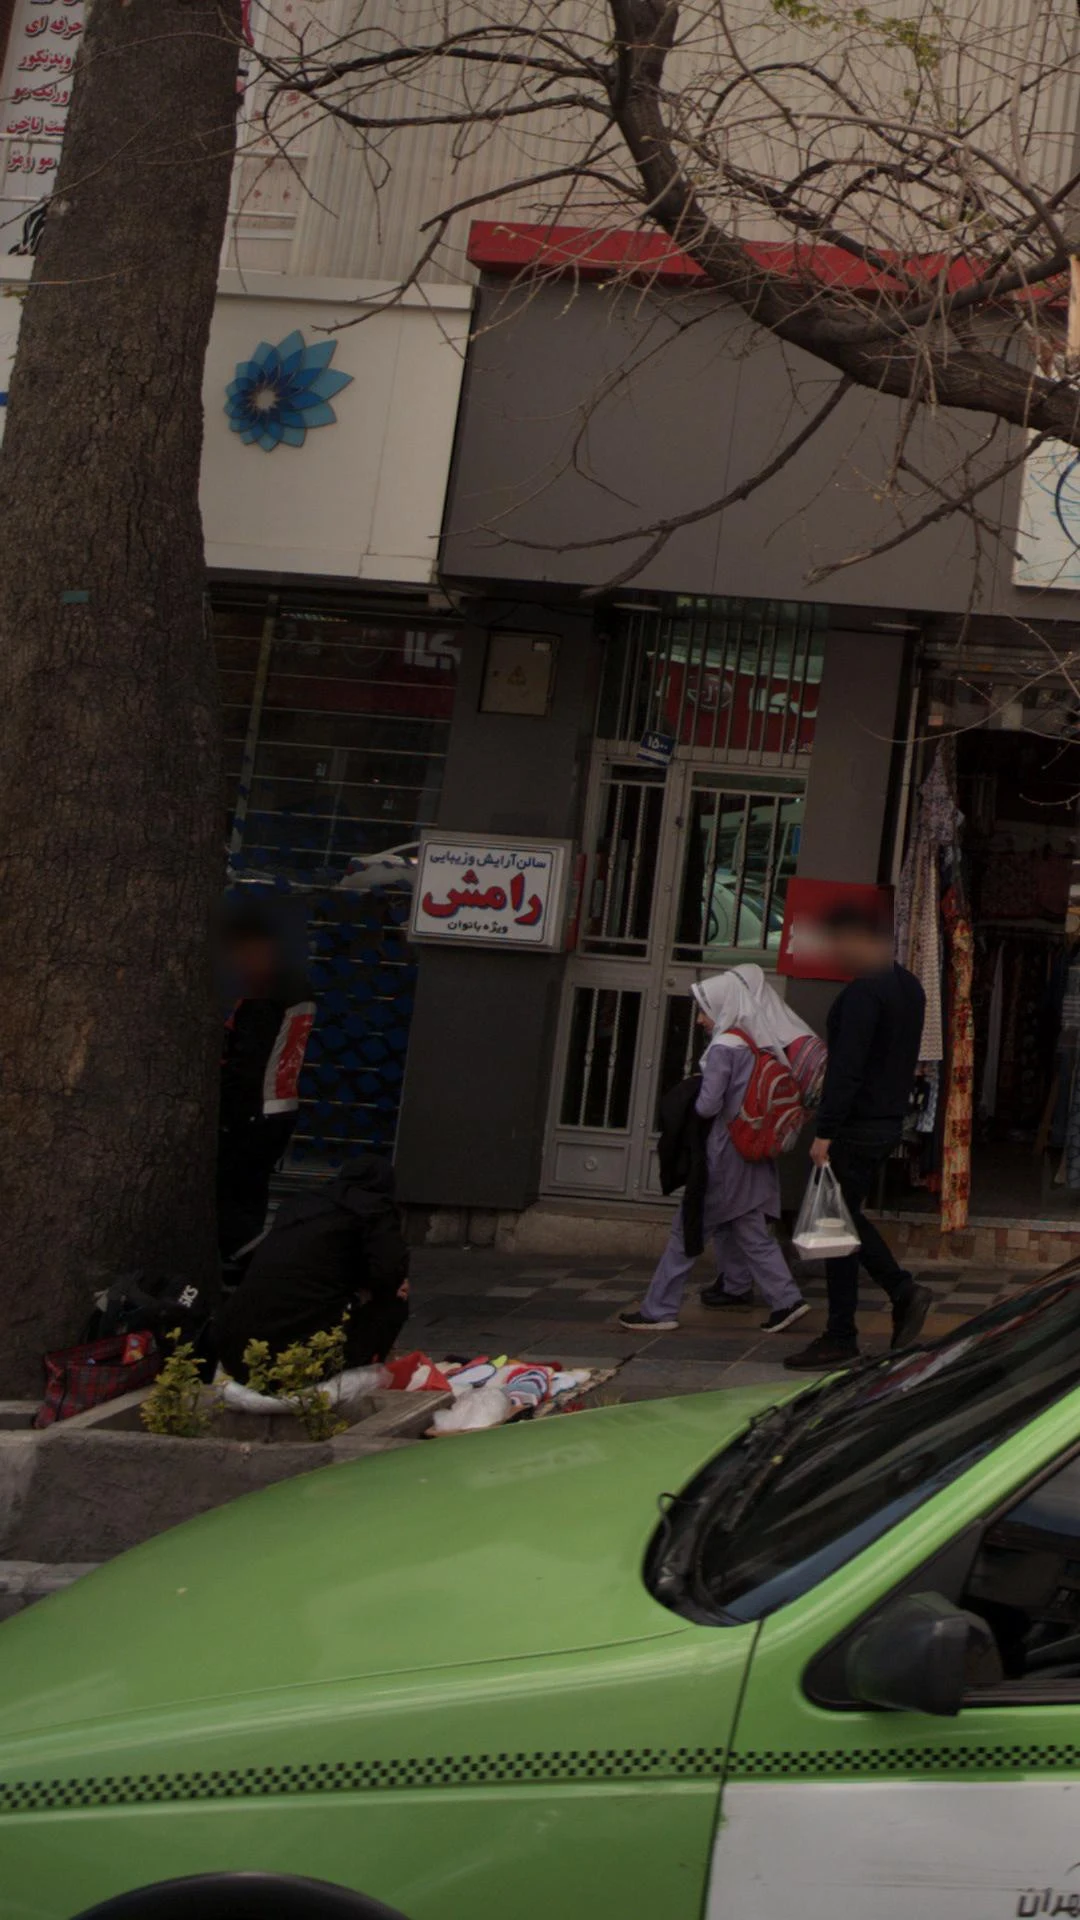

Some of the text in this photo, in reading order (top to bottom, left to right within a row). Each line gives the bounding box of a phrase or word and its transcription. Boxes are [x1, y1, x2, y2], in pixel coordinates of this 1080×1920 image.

[477, 853, 518, 869] آرایش
[517, 856, 547, 870] سالن
[422, 869, 543, 925] رامش
[447, 919, 509, 934] ویژه بانوان
[1016, 1886, 1080, 1919] هران
